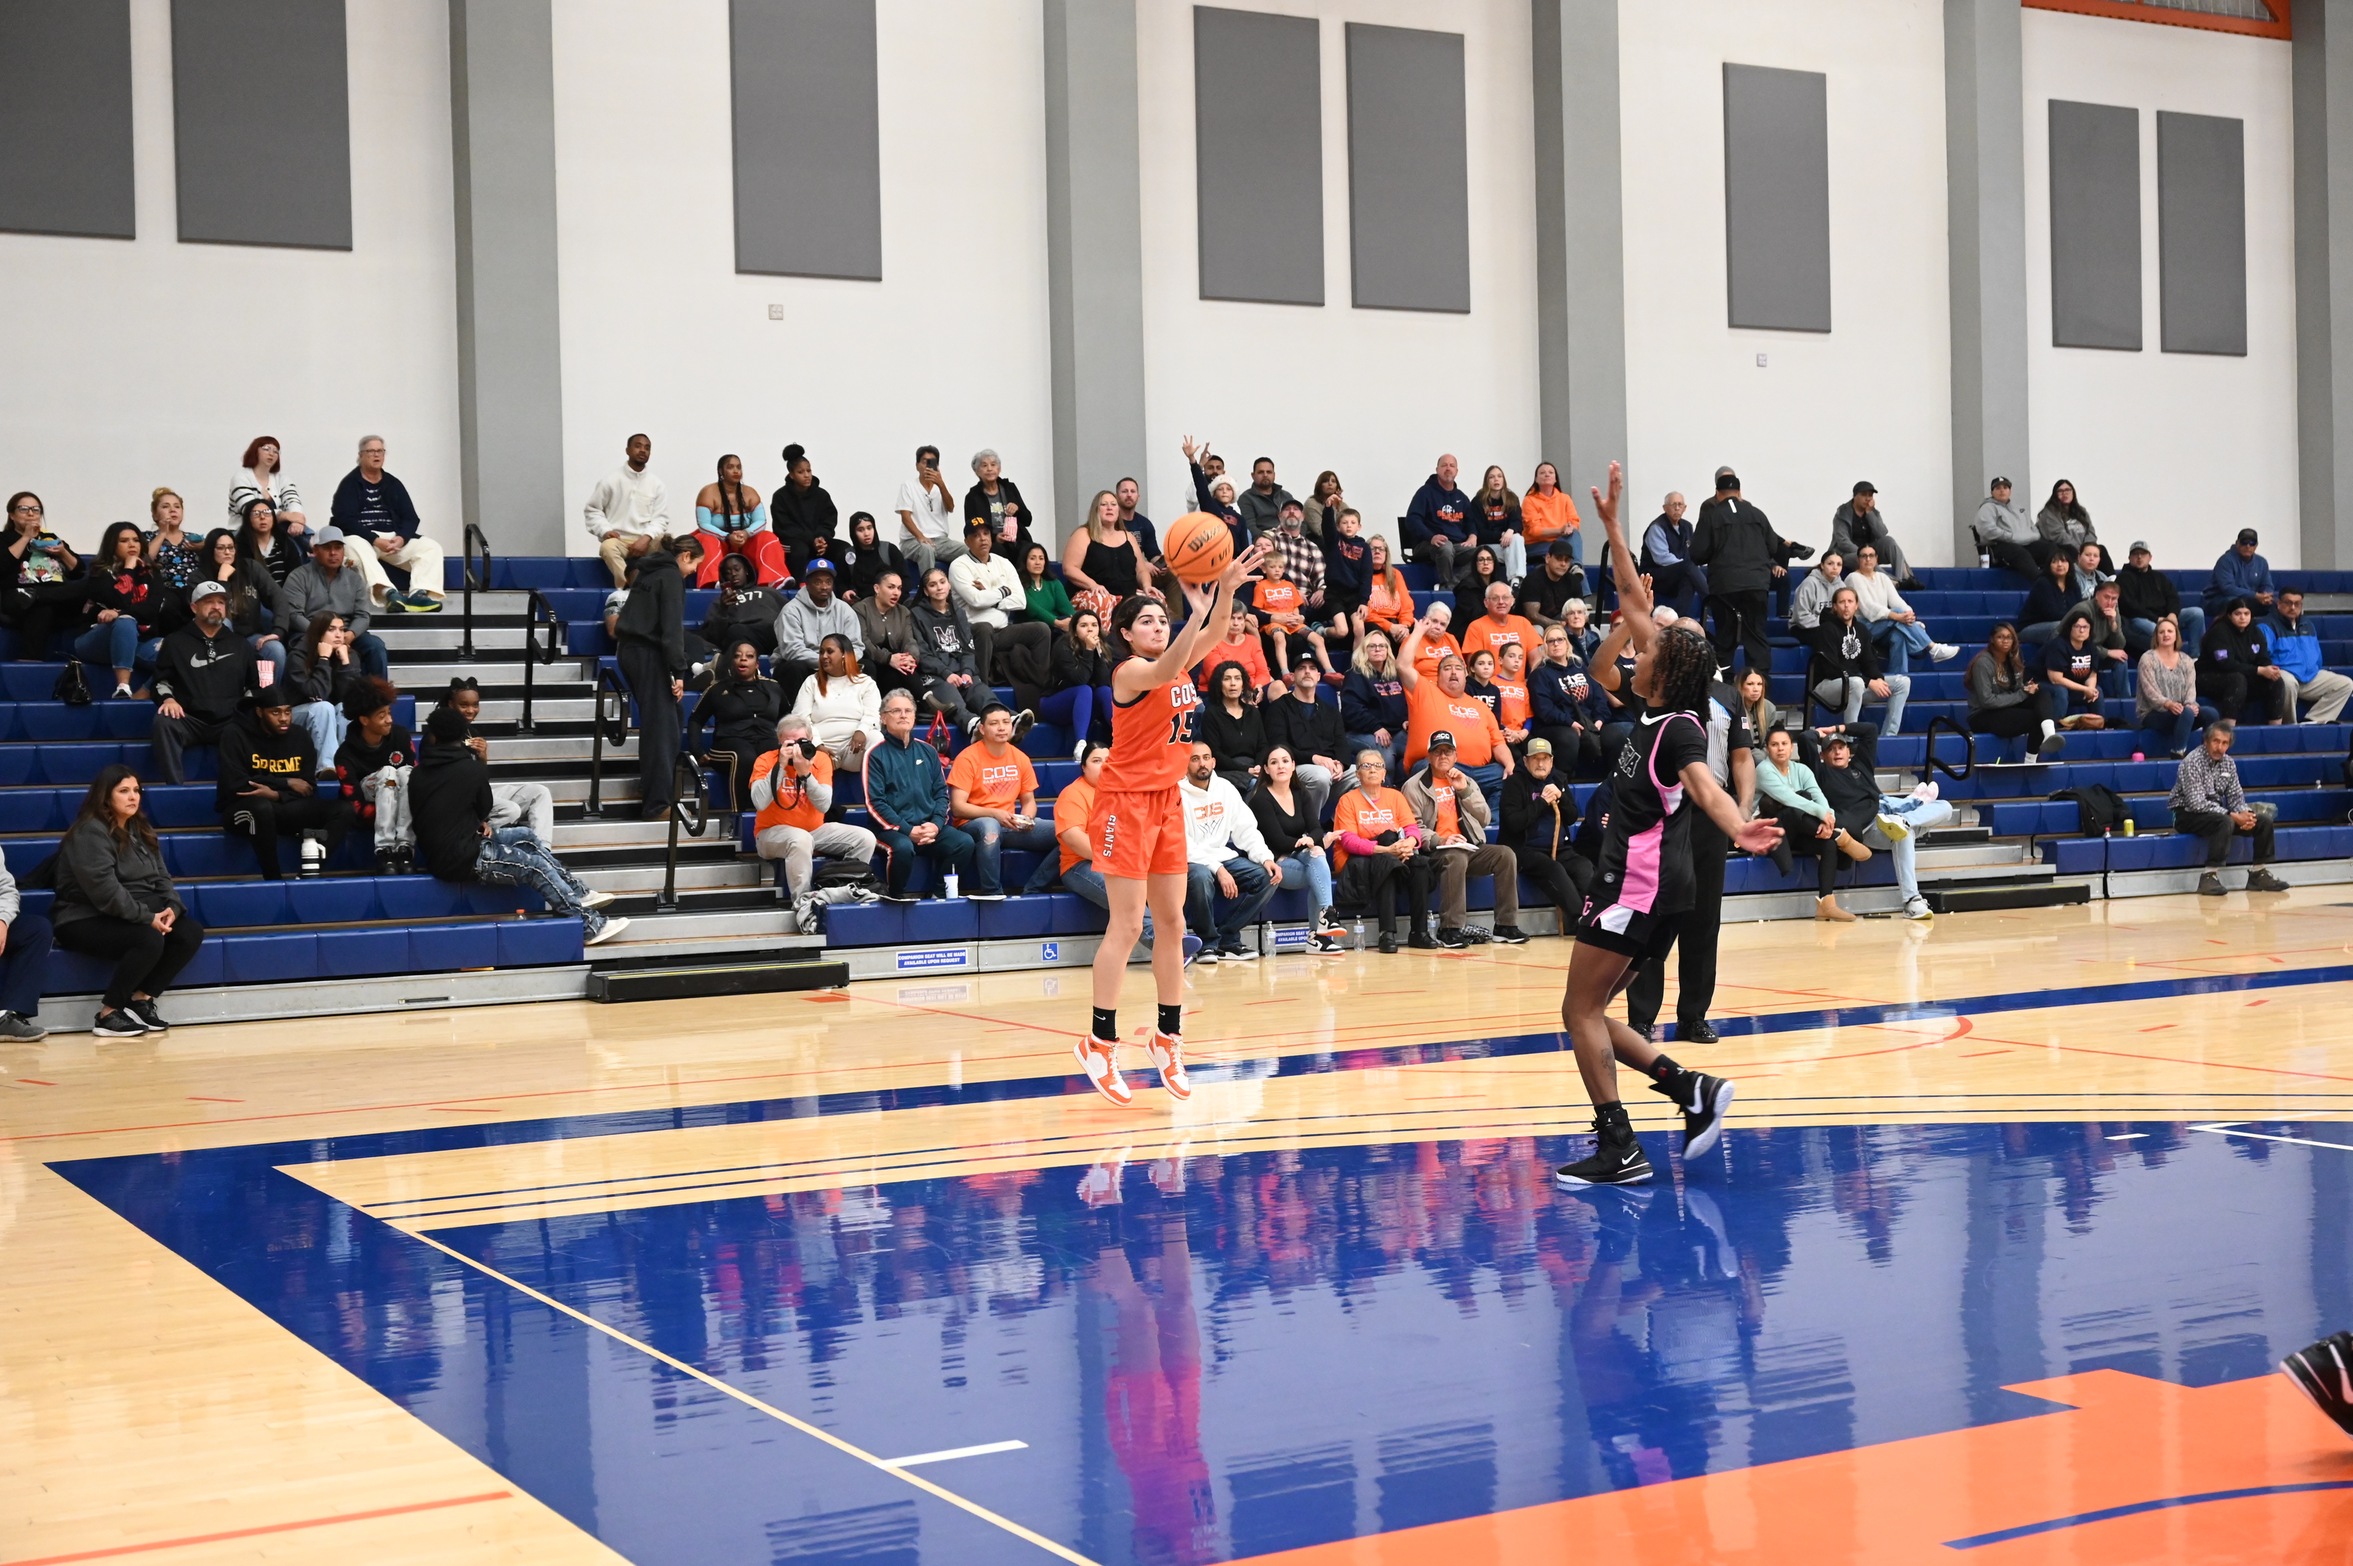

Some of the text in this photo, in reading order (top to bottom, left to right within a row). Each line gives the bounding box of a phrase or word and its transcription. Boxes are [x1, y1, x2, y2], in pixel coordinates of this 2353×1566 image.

[736, 590, 763, 605] 977
[1265, 587, 1292, 598] COS
[1490, 632, 1520, 643] COS
[1425, 646, 1453, 657] COS
[1170, 682, 1197, 708] COS
[1498, 685, 1525, 697] COS
[1448, 703, 1479, 716] COS
[1167, 710, 1193, 745] 15
[252, 753, 302, 773] SPREME
[982, 764, 1019, 780] COS
[1359, 809, 1394, 821] COS
[1102, 814, 1117, 858] GIANTS
